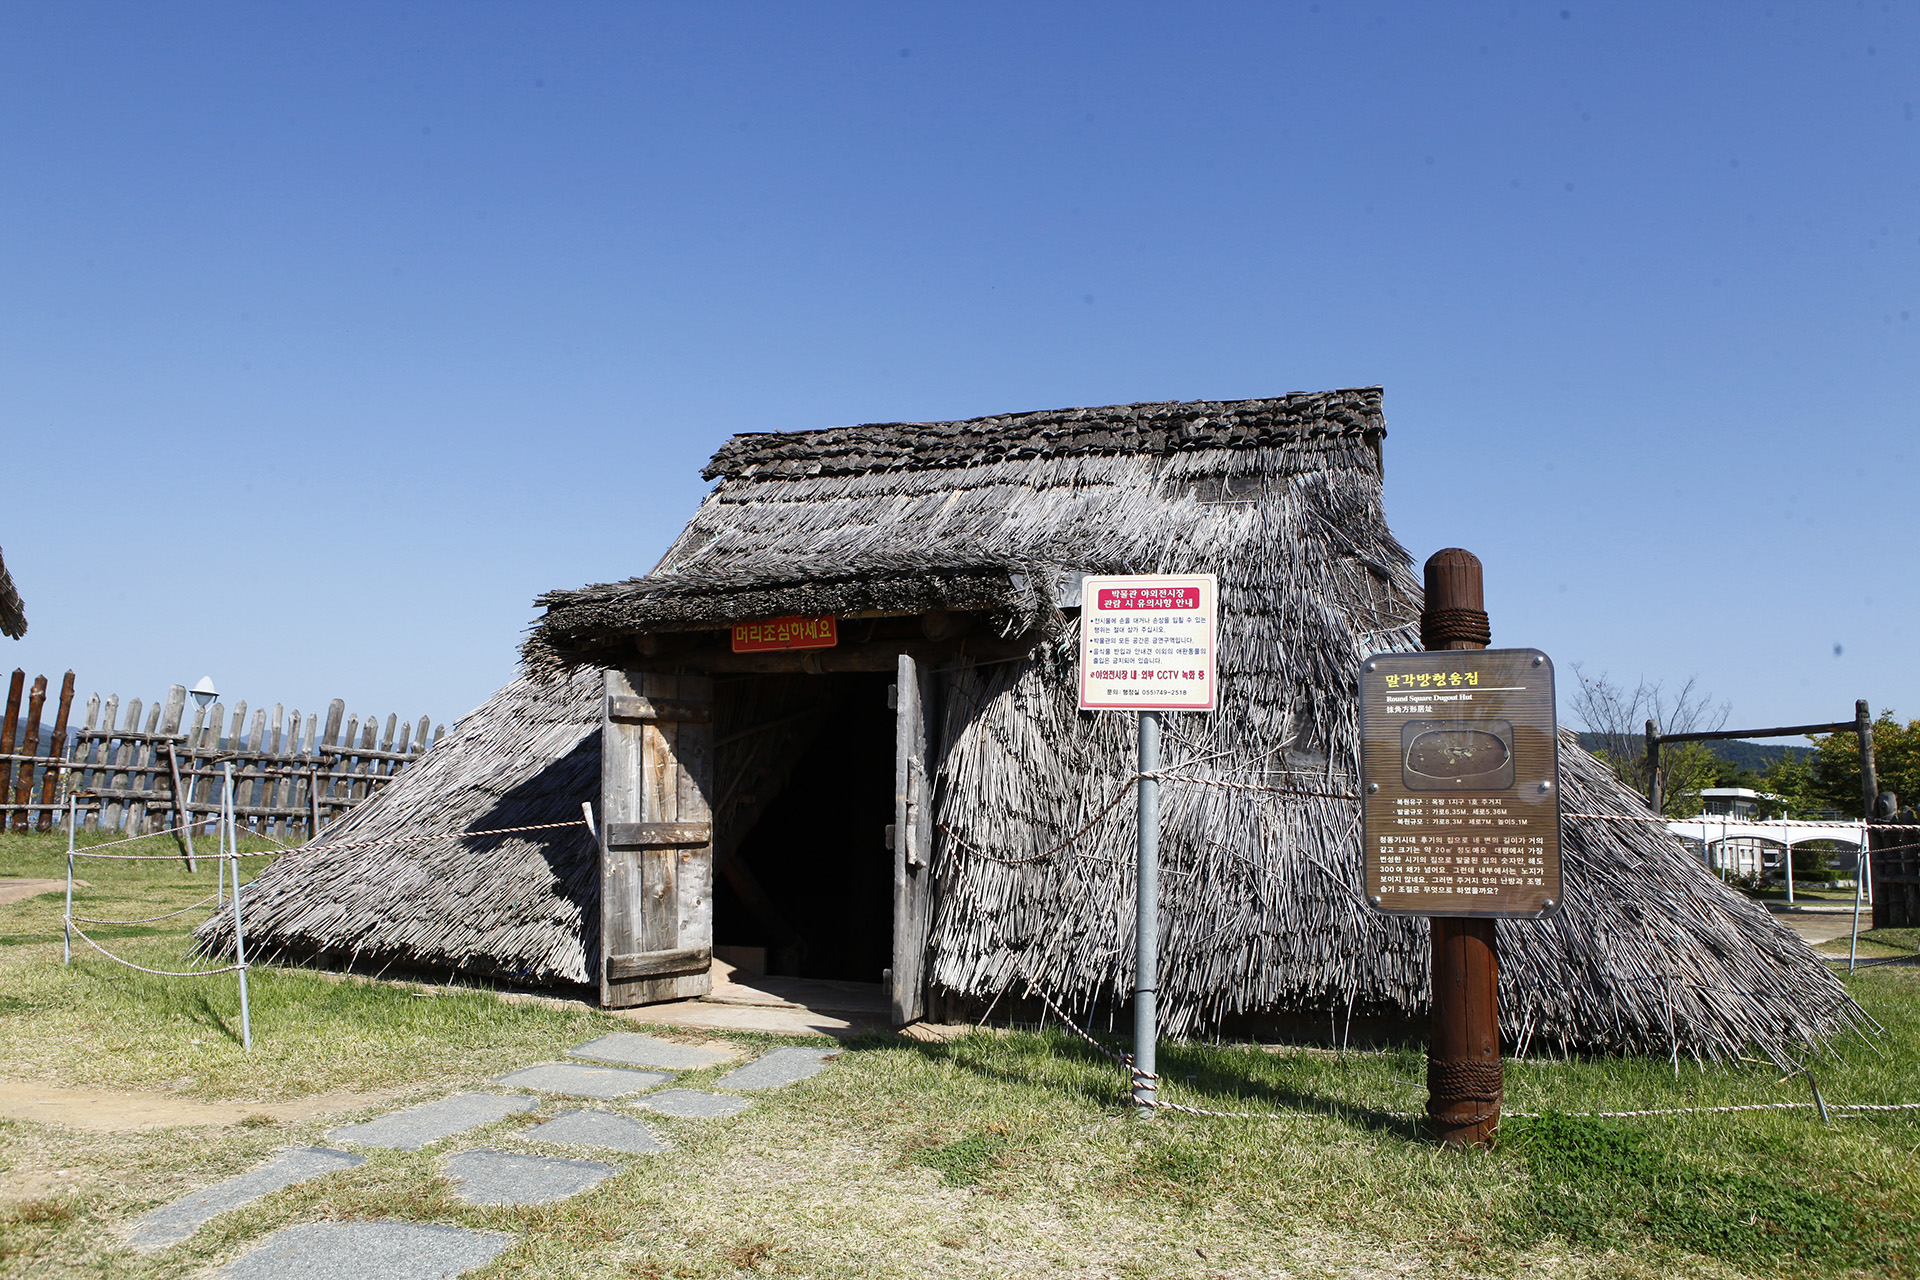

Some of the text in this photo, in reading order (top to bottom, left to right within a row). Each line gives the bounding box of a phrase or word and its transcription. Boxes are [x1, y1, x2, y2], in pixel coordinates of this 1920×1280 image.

[1111, 589, 1185, 599] 박물관 야외전시장
[1104, 598, 1193, 609] 관람 시 유의사항 안내
[736, 620, 832, 644] 머리조심하세요
[1157, 670, 1179, 680] CCTV
[1182, 670, 1195, 680] 녹화
[1198, 670, 1205, 680] 중
[1385, 671, 1478, 688] 말각방형움집
[1409, 695, 1432, 703] Square
[1433, 694, 1458, 702] Dugout
[1380, 836, 1416, 844] 청동기시대
[1420, 836, 1443, 844] 후기의
[1447, 836, 1468, 844] 집으로
[1503, 837, 1526, 845] 길이가
[1528, 837, 1544, 845] 거의
[1380, 846, 1394, 854] 같고
[1398, 846, 1420, 854] 크기는
[1424, 846, 1432, 854] 약
[1494, 847, 1524, 855] 대평에서
[1528, 847, 1544, 855] 가장
[1380, 856, 1401, 864] 번성한
[1404, 856, 1427, 864] 시기의
[1430, 856, 1452, 864] 집으로
[1455, 856, 1478, 864] 발굴된
[1482, 857, 1497, 865] 집의
[1528, 857, 1544, 865] 해도
[1478, 867, 1517, 875] 내부에서는
[1521, 867, 1544, 876] 노지가
[1380, 875, 1401, 883] 보이지
[1432, 876, 1453, 884] 그러면
[1456, 876, 1479, 884] 주거지
[1481, 877, 1497, 885] 안의
[1500, 877, 1523, 885] 난방과
[1380, 885, 1395, 893] 습기
[1423, 886, 1453, 894] 무엇으로
